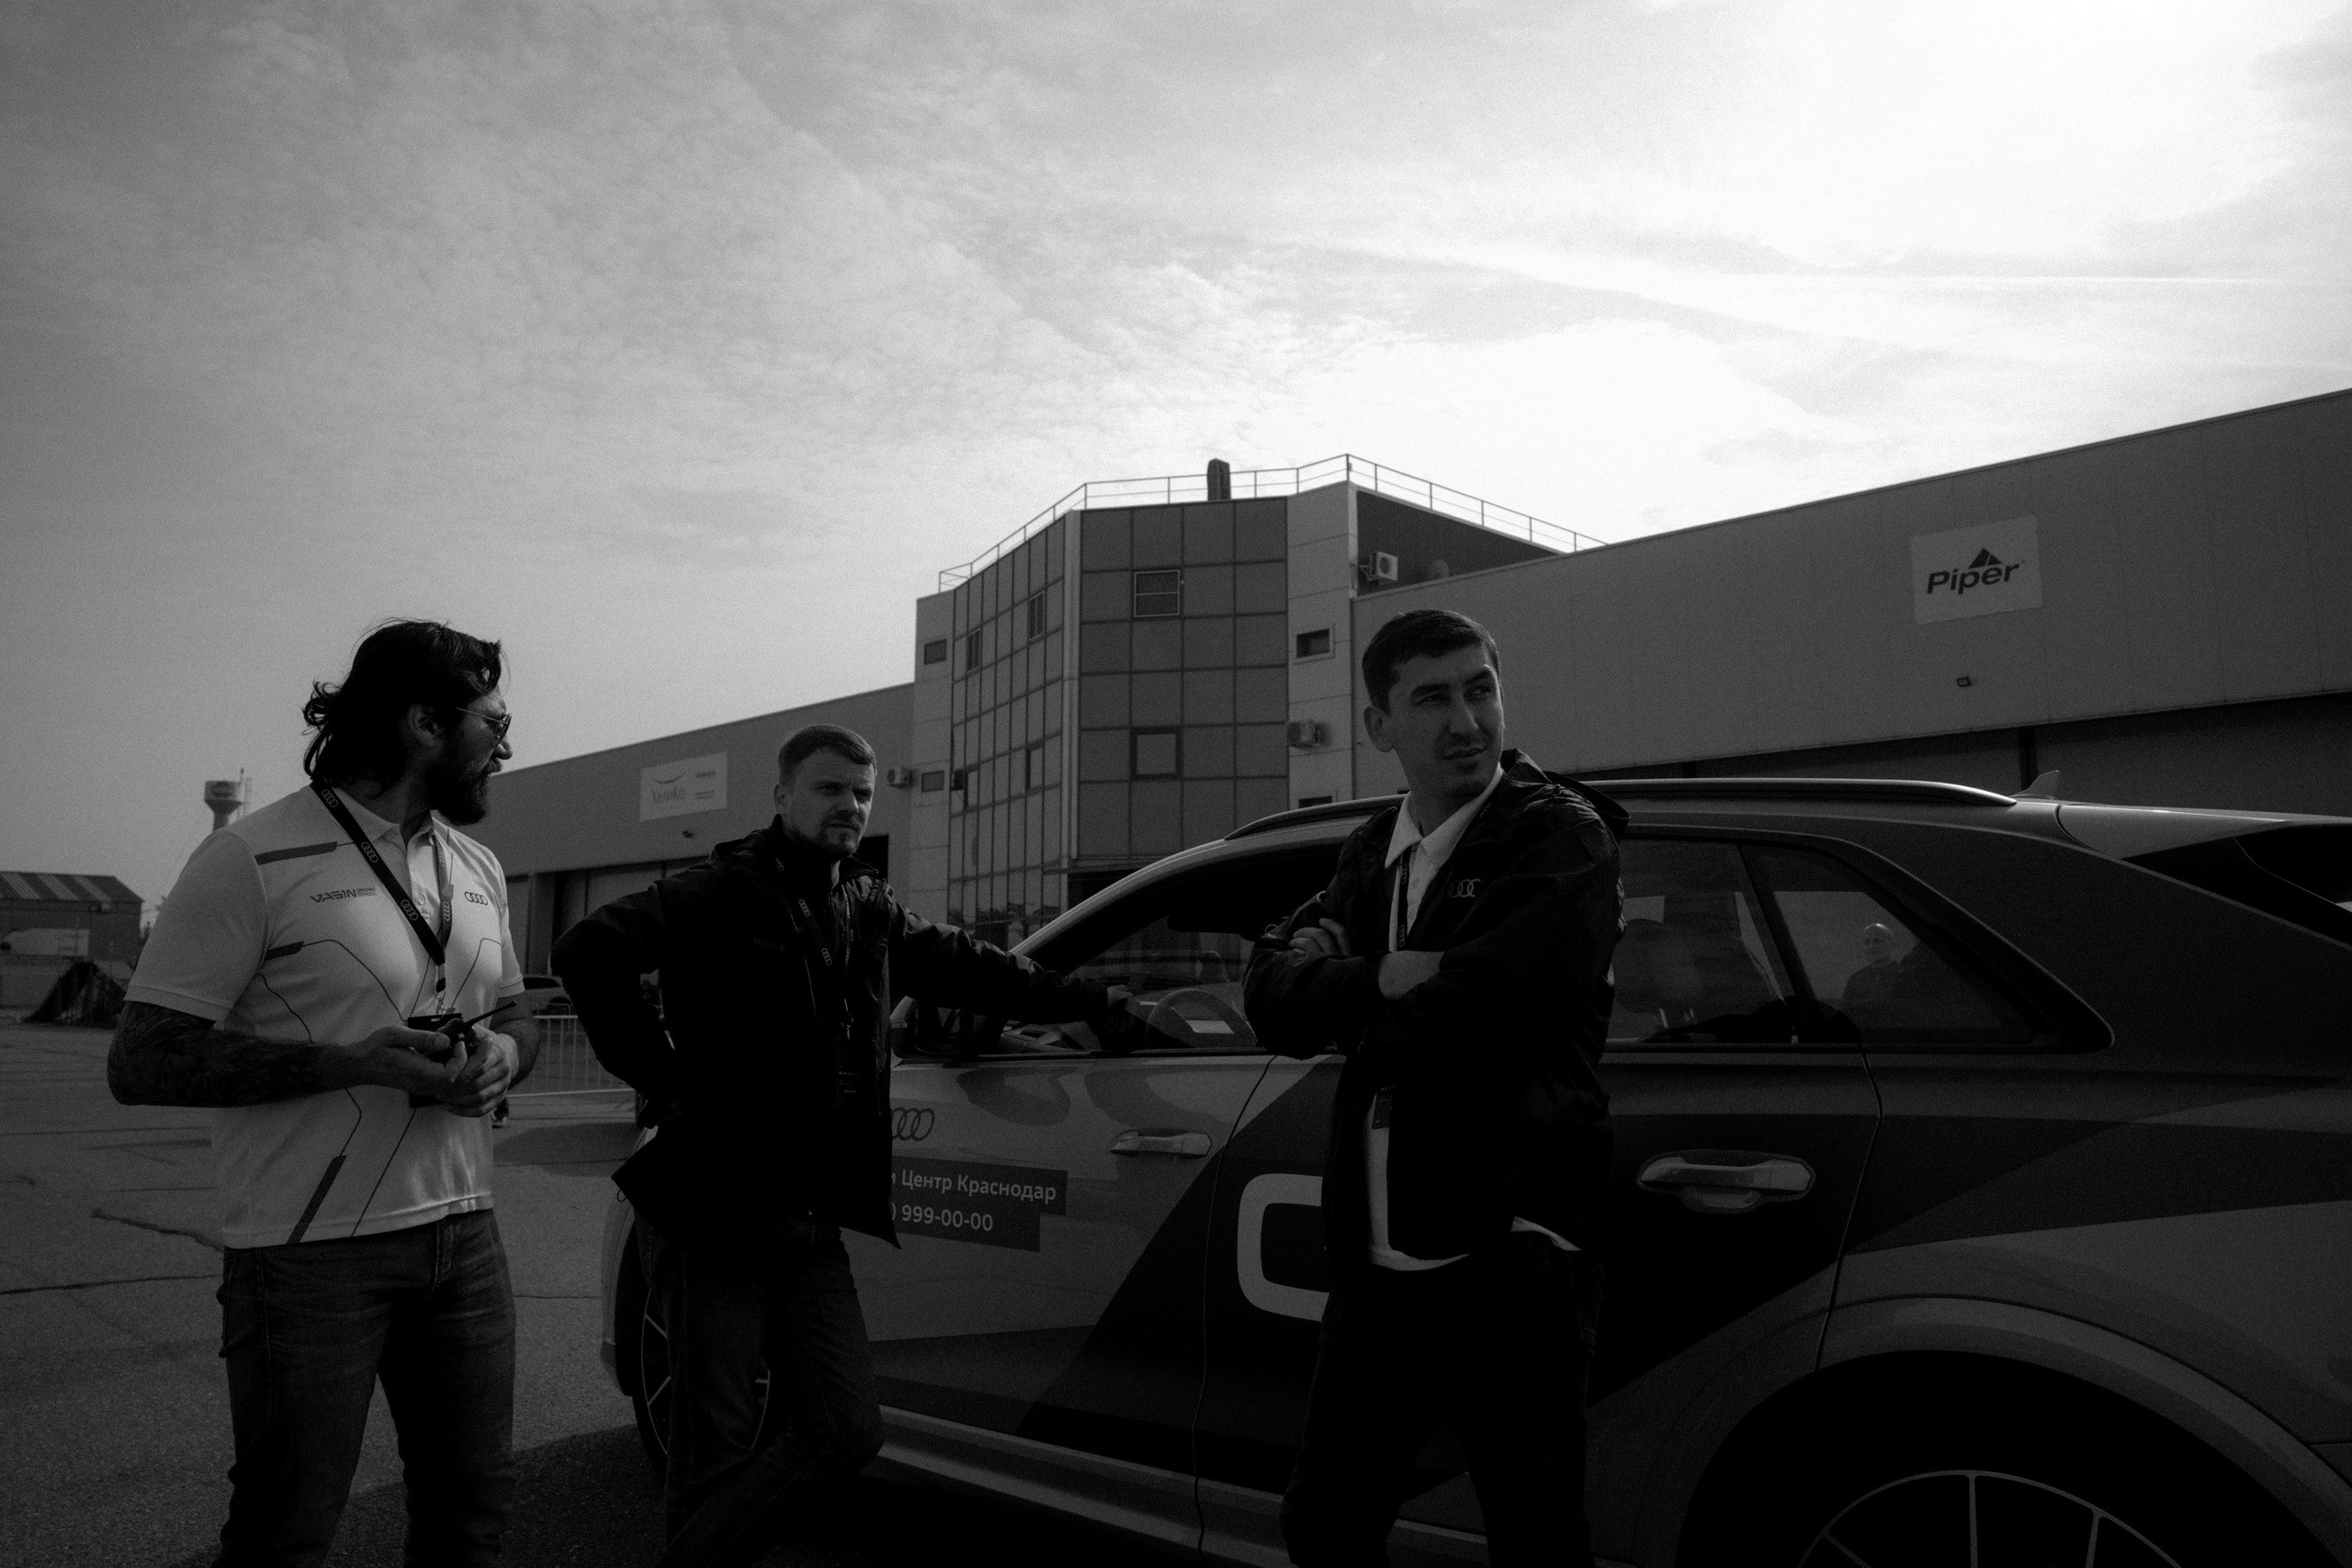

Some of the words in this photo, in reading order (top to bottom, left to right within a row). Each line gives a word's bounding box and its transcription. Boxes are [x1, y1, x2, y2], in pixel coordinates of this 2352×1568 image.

[1927, 563, 2019, 595] Piper
[901, 1168, 952, 1194] Центр
[957, 1174, 1057, 1204] Краснодар
[901, 1204, 993, 1232] 999-00-00
